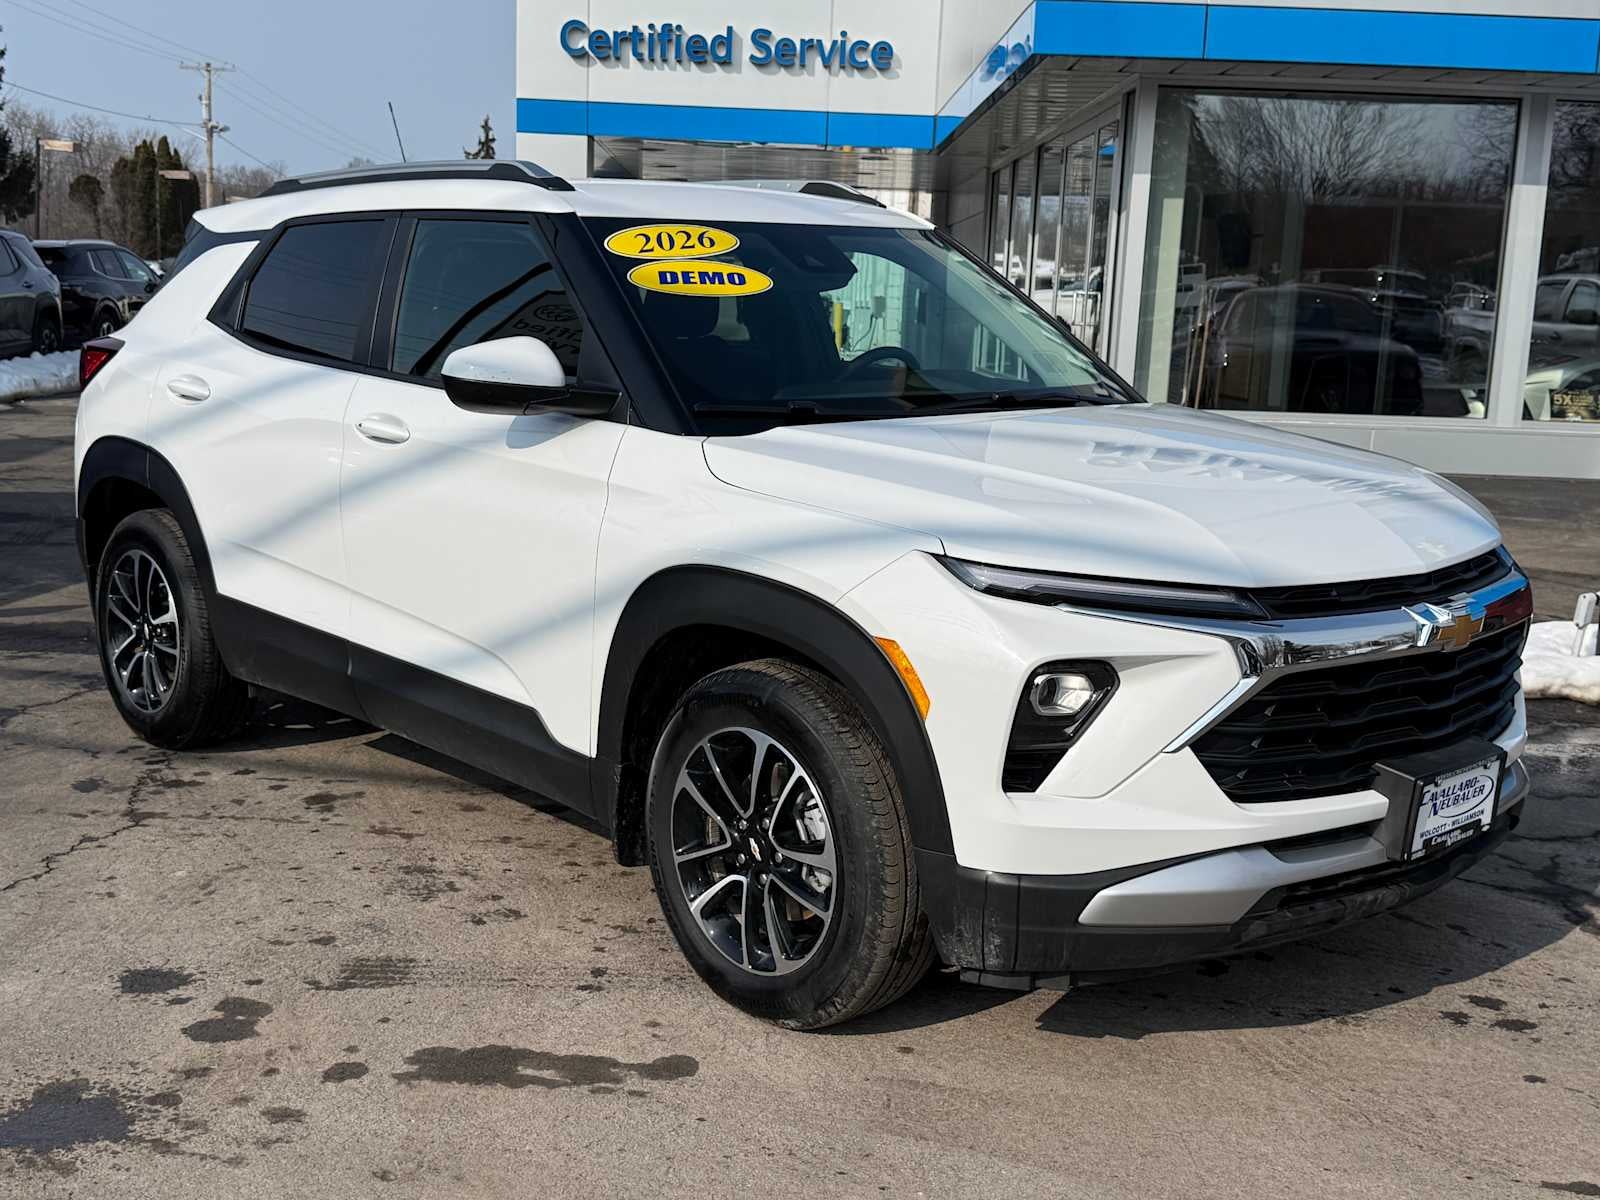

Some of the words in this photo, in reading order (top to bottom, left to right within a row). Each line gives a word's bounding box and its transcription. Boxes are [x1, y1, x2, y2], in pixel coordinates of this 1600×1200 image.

[560, 19, 734, 65] Certified
[750, 28, 894, 71] Service
[634, 229, 716, 254] 2026
[658, 270, 746, 287] DEMO
[1428, 784, 1485, 818] NEUBAUER
[1420, 823, 1446, 838] WOLCOTT
[1451, 808, 1485, 827] WILLIAMSON
